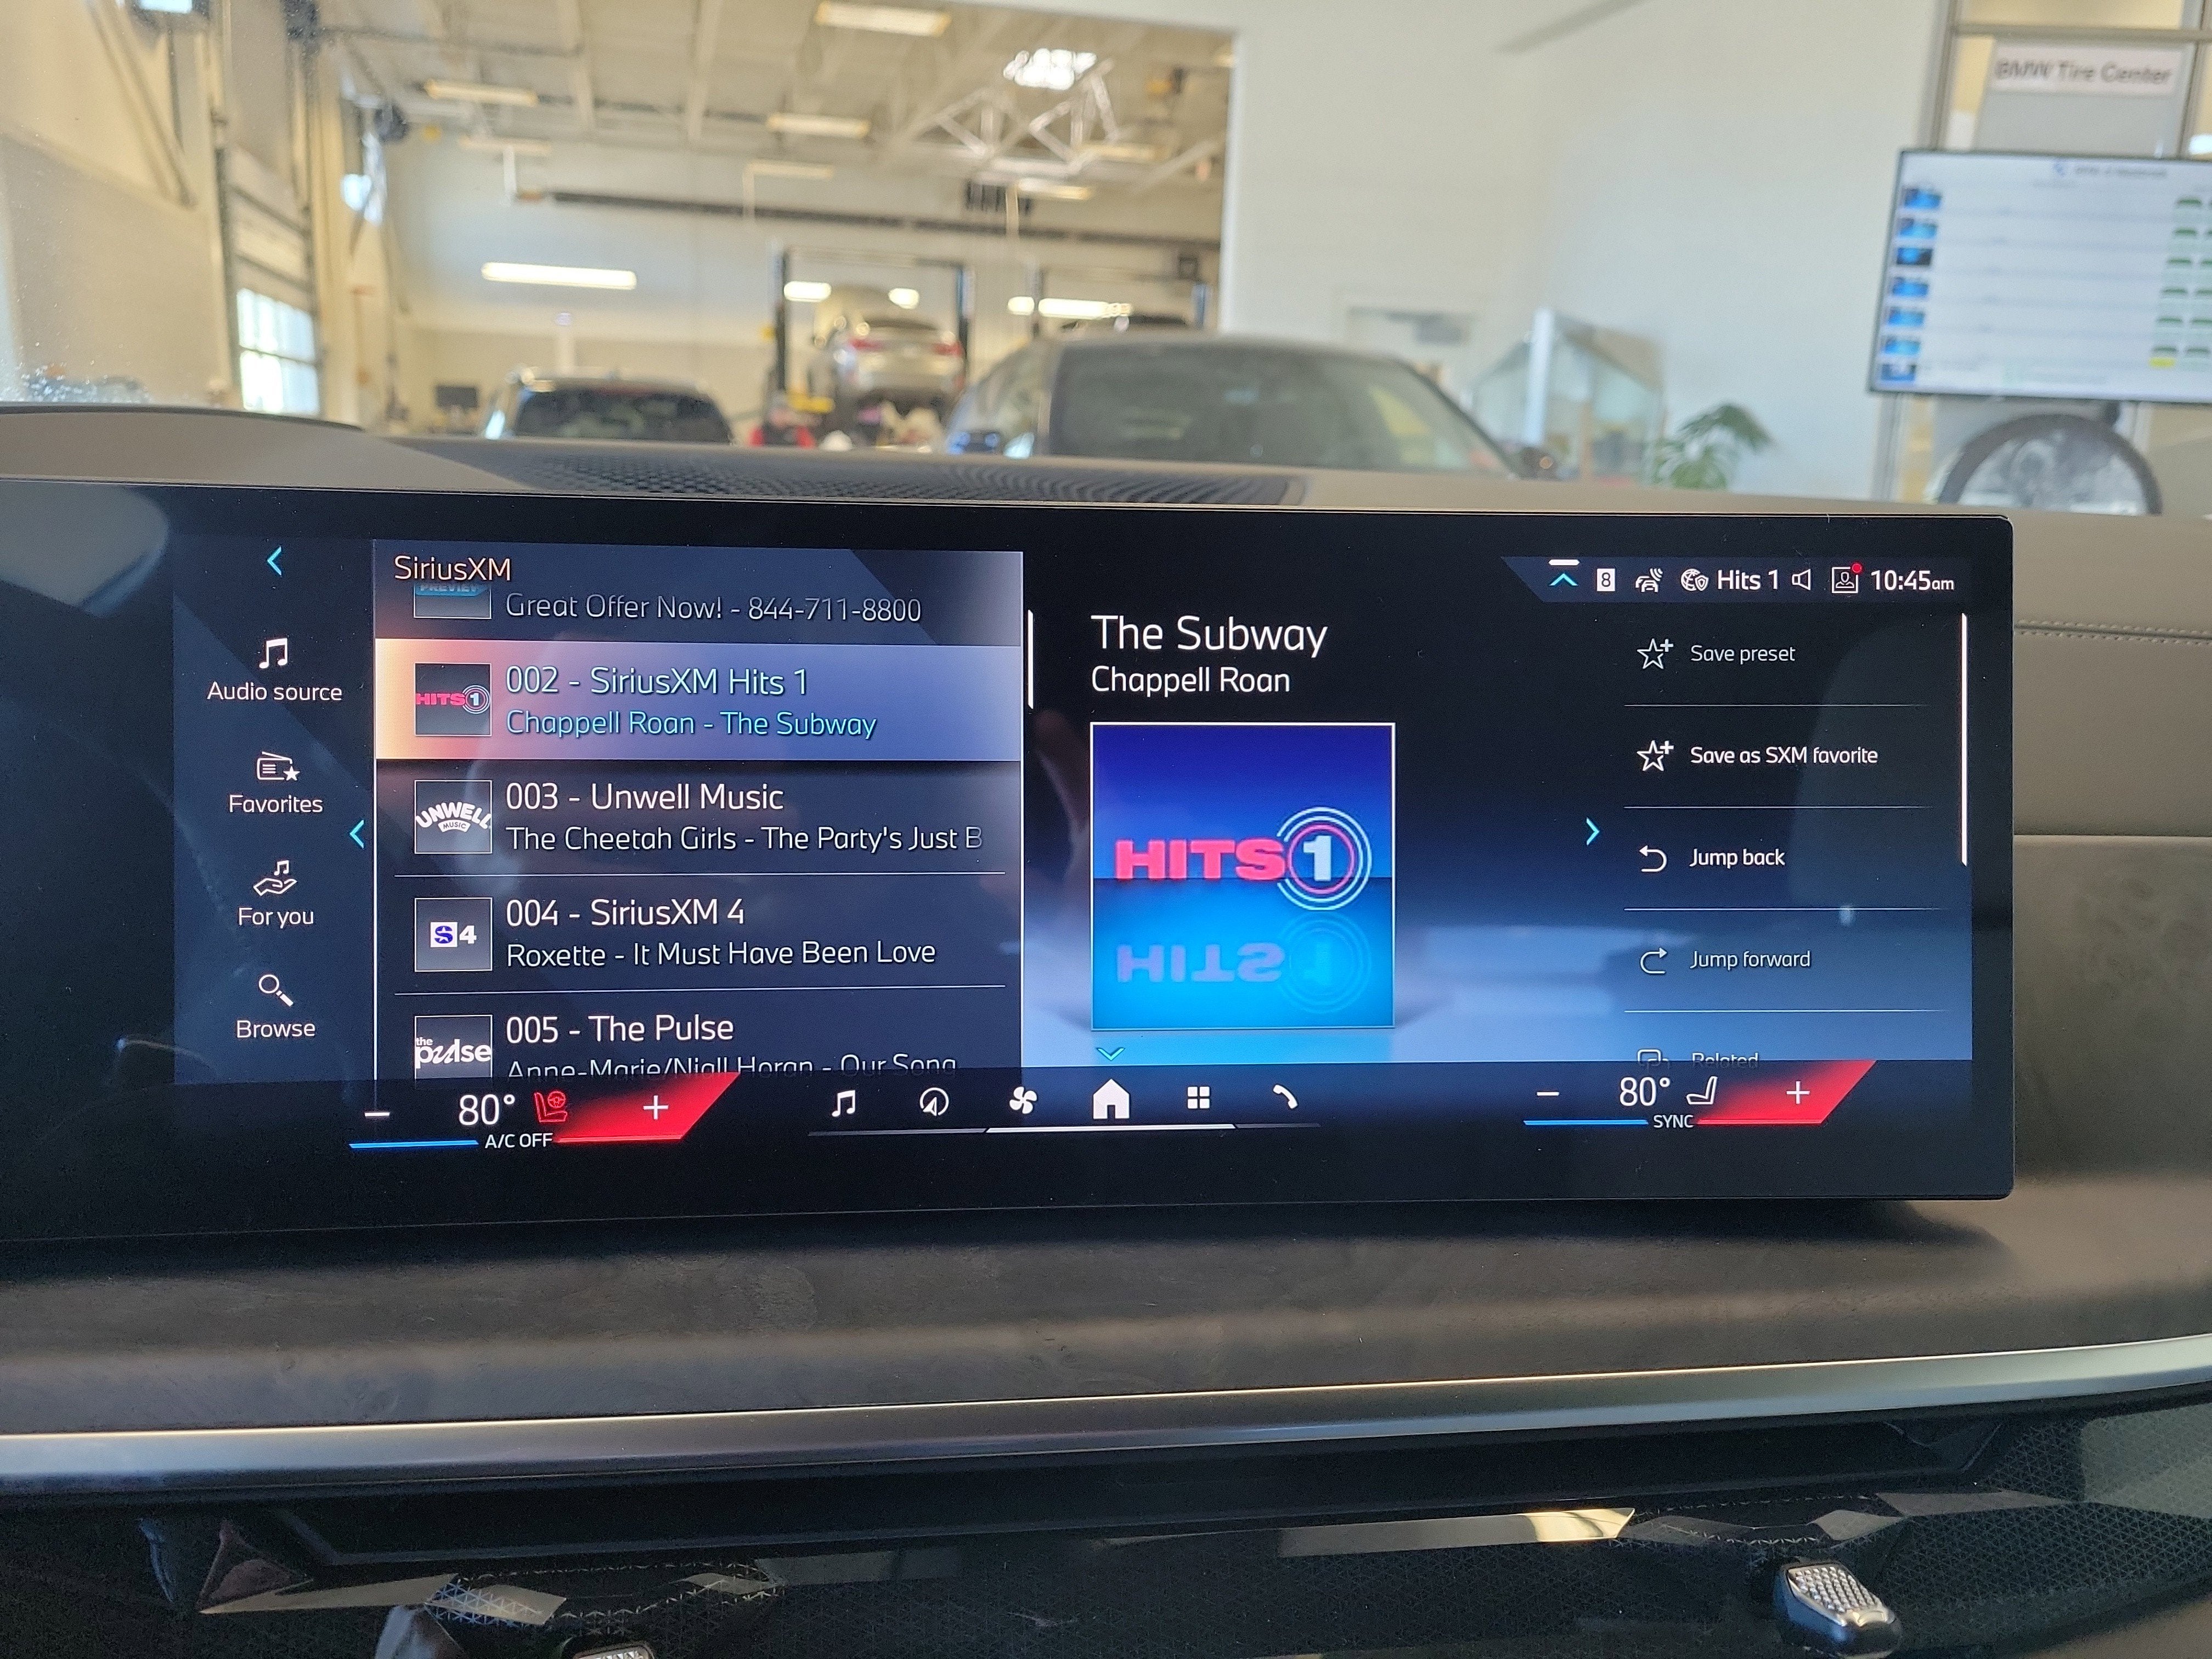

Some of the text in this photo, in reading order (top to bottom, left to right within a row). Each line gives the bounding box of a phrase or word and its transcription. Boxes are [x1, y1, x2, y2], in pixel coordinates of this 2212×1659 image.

[395, 556, 510, 580] SiriusXM
[1718, 569, 1778, 590] Hits 1
[1871, 570, 1954, 590] 10:45am
[507, 593, 577, 617] Great
[587, 595, 649, 617] Offer
[658, 596, 720, 618] Now!
[749, 597, 920, 621] 844-711-8800
[1091, 616, 1328, 658] The Subway
[1691, 645, 1795, 664] Save preset
[207, 682, 342, 700] Audio source
[507, 666, 557, 692] 002
[591, 667, 716, 693] SiriusXM
[730, 669, 783, 694] Hits
[794, 669, 804, 694] 1
[1092, 665, 1289, 697] Chappell Roan
[416, 693, 466, 706] HITS
[507, 710, 618, 737] Chappell
[630, 712, 693, 733] Roan
[720, 712, 767, 734] The
[777, 712, 876, 739] Subway
[1691, 747, 1878, 763] Save as SXM favorite
[230, 795, 323, 812] Favorites
[507, 783, 557, 809] 003
[592, 783, 689, 809] Unwell
[701, 783, 783, 809] Music
[416, 802, 492, 829] UNWELL
[506, 827, 555, 849] The
[566, 827, 671, 849] Cheetah
[681, 827, 736, 849] Girls
[761, 827, 808, 849] The
[819, 827, 901, 853] Party's
[909, 827, 957, 850] Just
[1115, 839, 1286, 880] HITS
[1690, 849, 1785, 868] Jump back
[239, 907, 313, 928] For you
[507, 900, 557, 926] 004
[591, 899, 717, 925] SiriusXM
[727, 899, 743, 923] 4
[508, 944, 605, 966] Roxette
[635, 943, 650, 965] It
[659, 943, 720, 964] Must
[730, 942, 792, 964] Have
[803, 941, 867, 963] Been
[878, 941, 935, 962] Love
[1690, 951, 1810, 970] Jump forward
[238, 1020, 315, 1037] Browse
[507, 1017, 558, 1043] 005
[588, 1016, 644, 1041] The
[656, 1014, 733, 1040] Pulse
[416, 1036, 433, 1046] the
[416, 1039, 492, 1069] pulse
[1620, 1077, 1670, 1106] 80°
[459, 1094, 515, 1125] 80°
[1654, 1115, 1693, 1128] SYNC
[485, 1133, 553, 1148] A/C OFF
